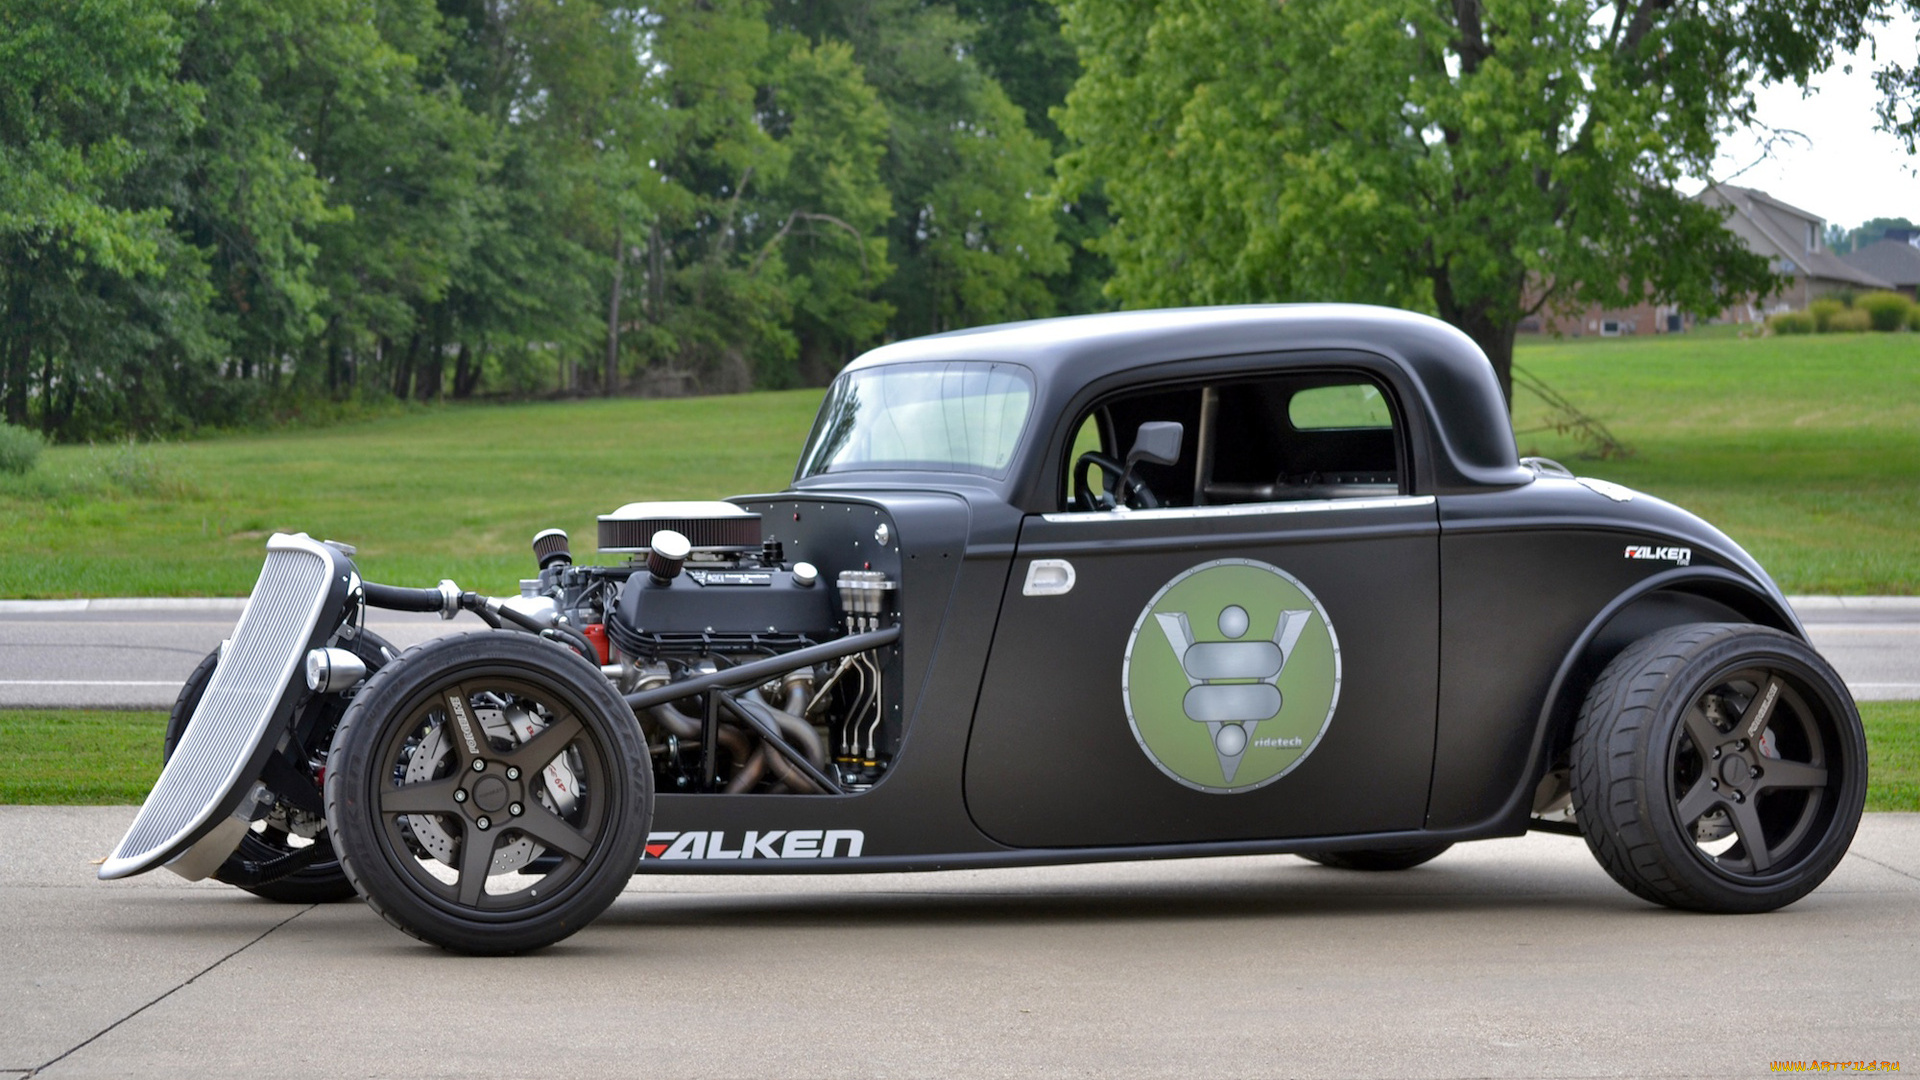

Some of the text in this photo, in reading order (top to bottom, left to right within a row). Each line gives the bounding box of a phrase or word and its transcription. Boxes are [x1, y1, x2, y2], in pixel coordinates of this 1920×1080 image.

[1624, 545, 1691, 560] FALKEN
[449, 696, 480, 754] FORGELINE
[1254, 736, 1302, 747] ridetech
[639, 830, 864, 860] FALKEN
